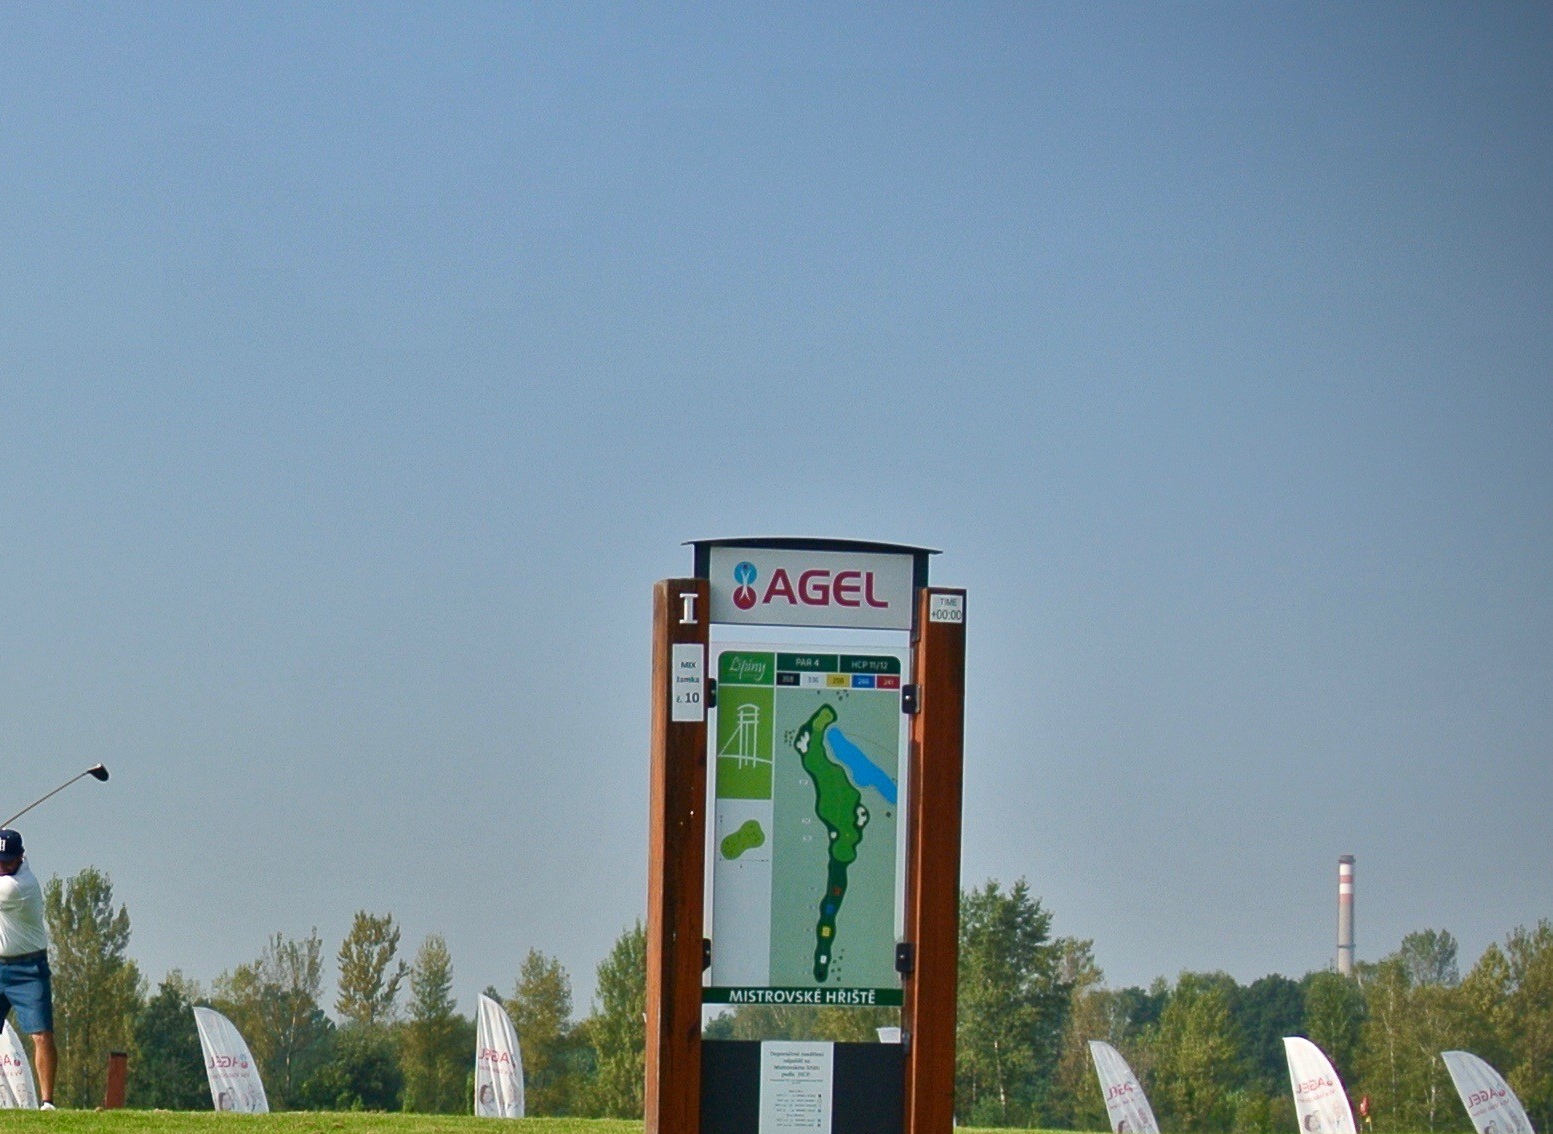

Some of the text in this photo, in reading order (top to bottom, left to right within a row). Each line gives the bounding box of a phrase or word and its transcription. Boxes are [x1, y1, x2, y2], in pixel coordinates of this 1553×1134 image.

[762, 568, 889, 608] AGEL
[795, 658, 820, 667] PAR 4
[851, 661, 868, 670] HCP
[685, 692, 700, 704] 10
[728, 988, 876, 1004] MISTROVSKÉ HŘIŠTĚ
